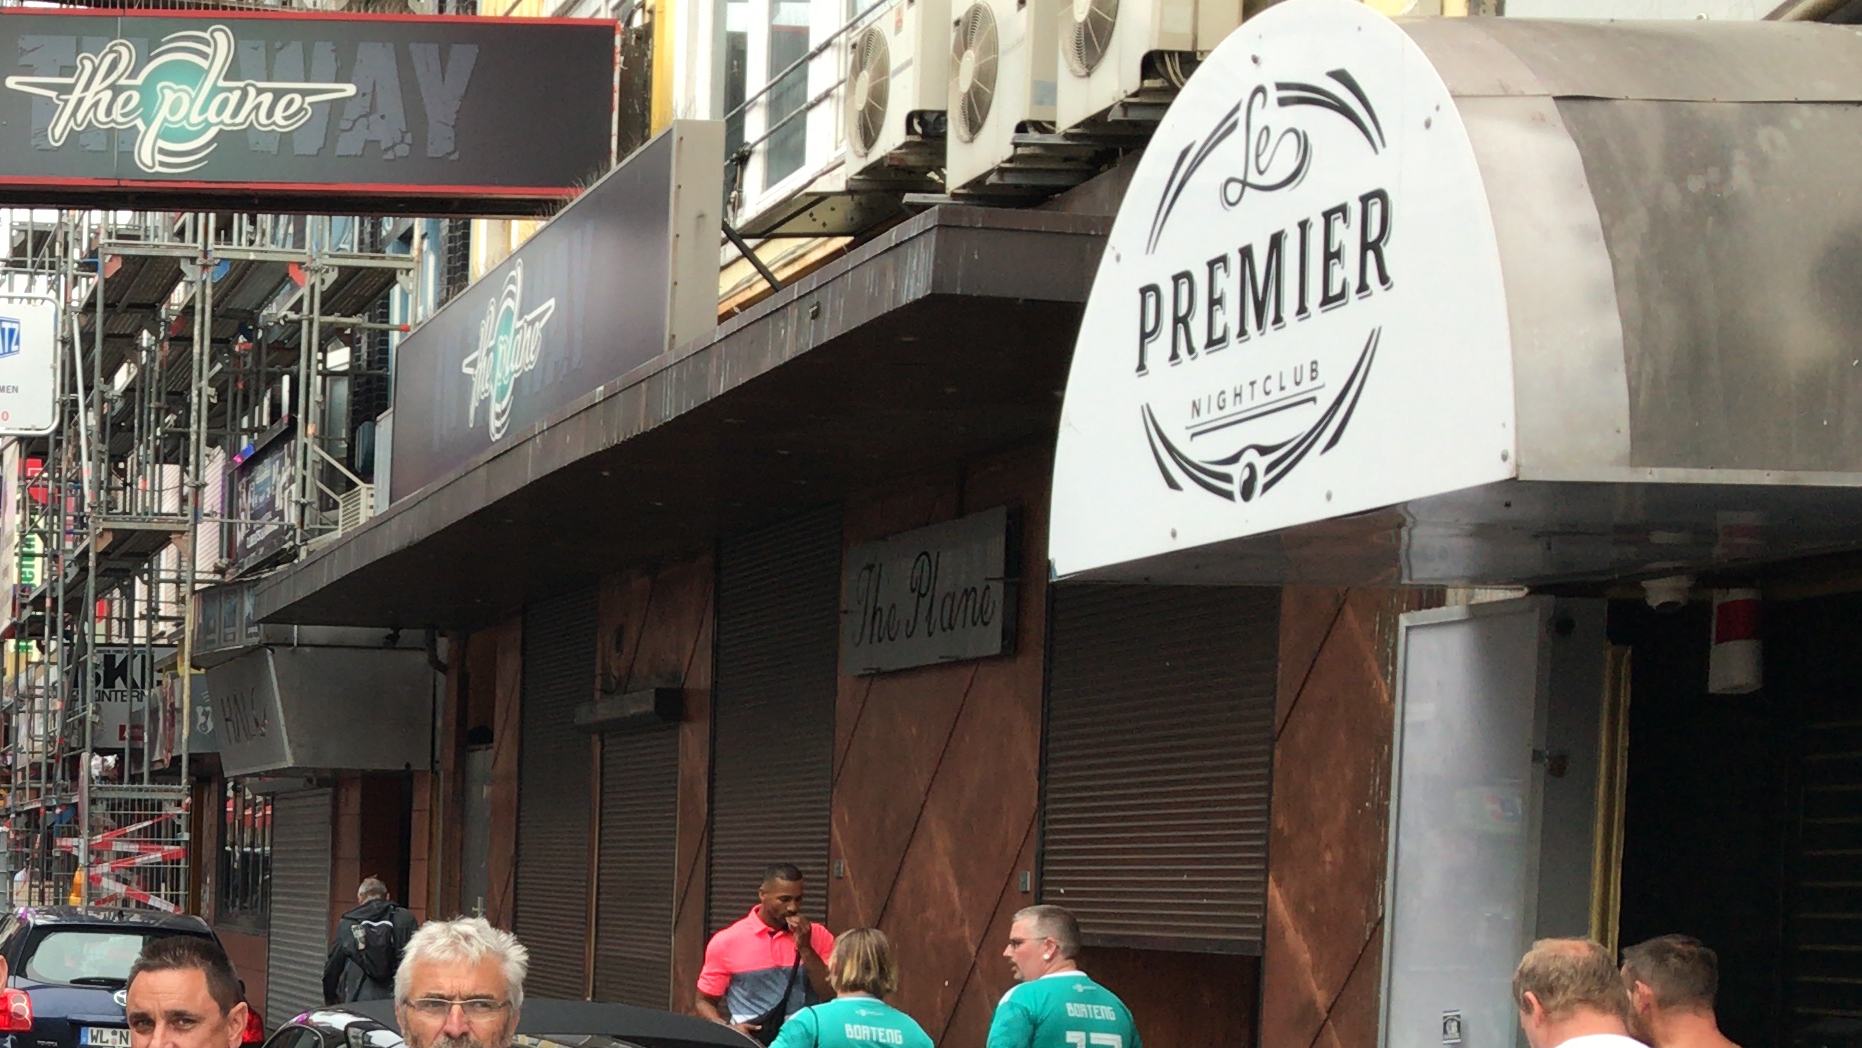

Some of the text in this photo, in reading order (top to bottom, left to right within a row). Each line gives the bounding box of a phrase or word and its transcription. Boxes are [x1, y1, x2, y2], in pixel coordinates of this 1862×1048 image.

[49, 24, 311, 172] the plane
[1220, 84, 1312, 211] Le
[1136, 187, 1394, 379] PREMIER
[1191, 360, 1322, 419] NIGHTCLUB
[851, 551, 996, 647] The Plane
[90, 1029, 109, 1044] WL
[844, 1023, 903, 1044] BOATENG
[1065, 1002, 1116, 1020] BOATENG
